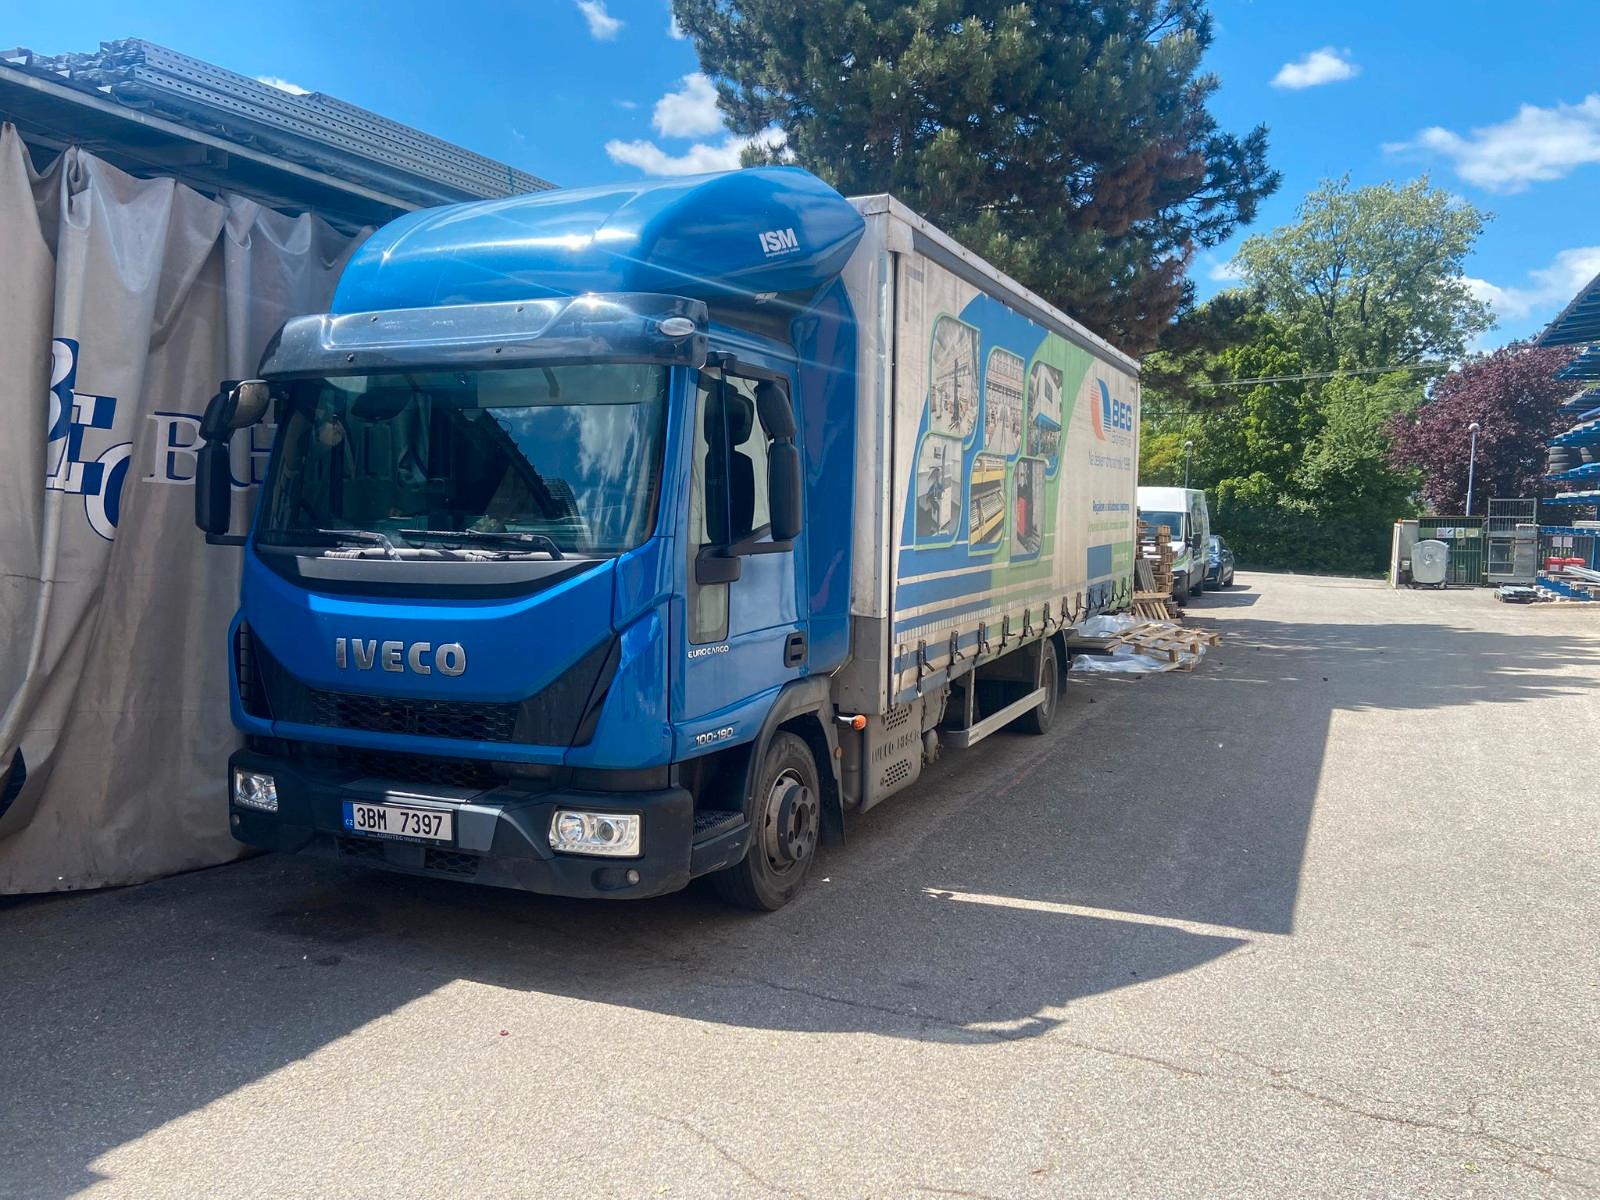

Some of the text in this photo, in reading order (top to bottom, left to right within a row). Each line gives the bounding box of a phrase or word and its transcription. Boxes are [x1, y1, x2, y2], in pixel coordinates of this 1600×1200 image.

[759, 228, 798, 253] ISM
[1112, 399, 1132, 432] BEG
[336, 637, 466, 677] IVECO
[687, 645, 730, 659] EUROCARGO
[696, 727, 734, 745] 100-190
[357, 807, 442, 836] 3BM 7397
